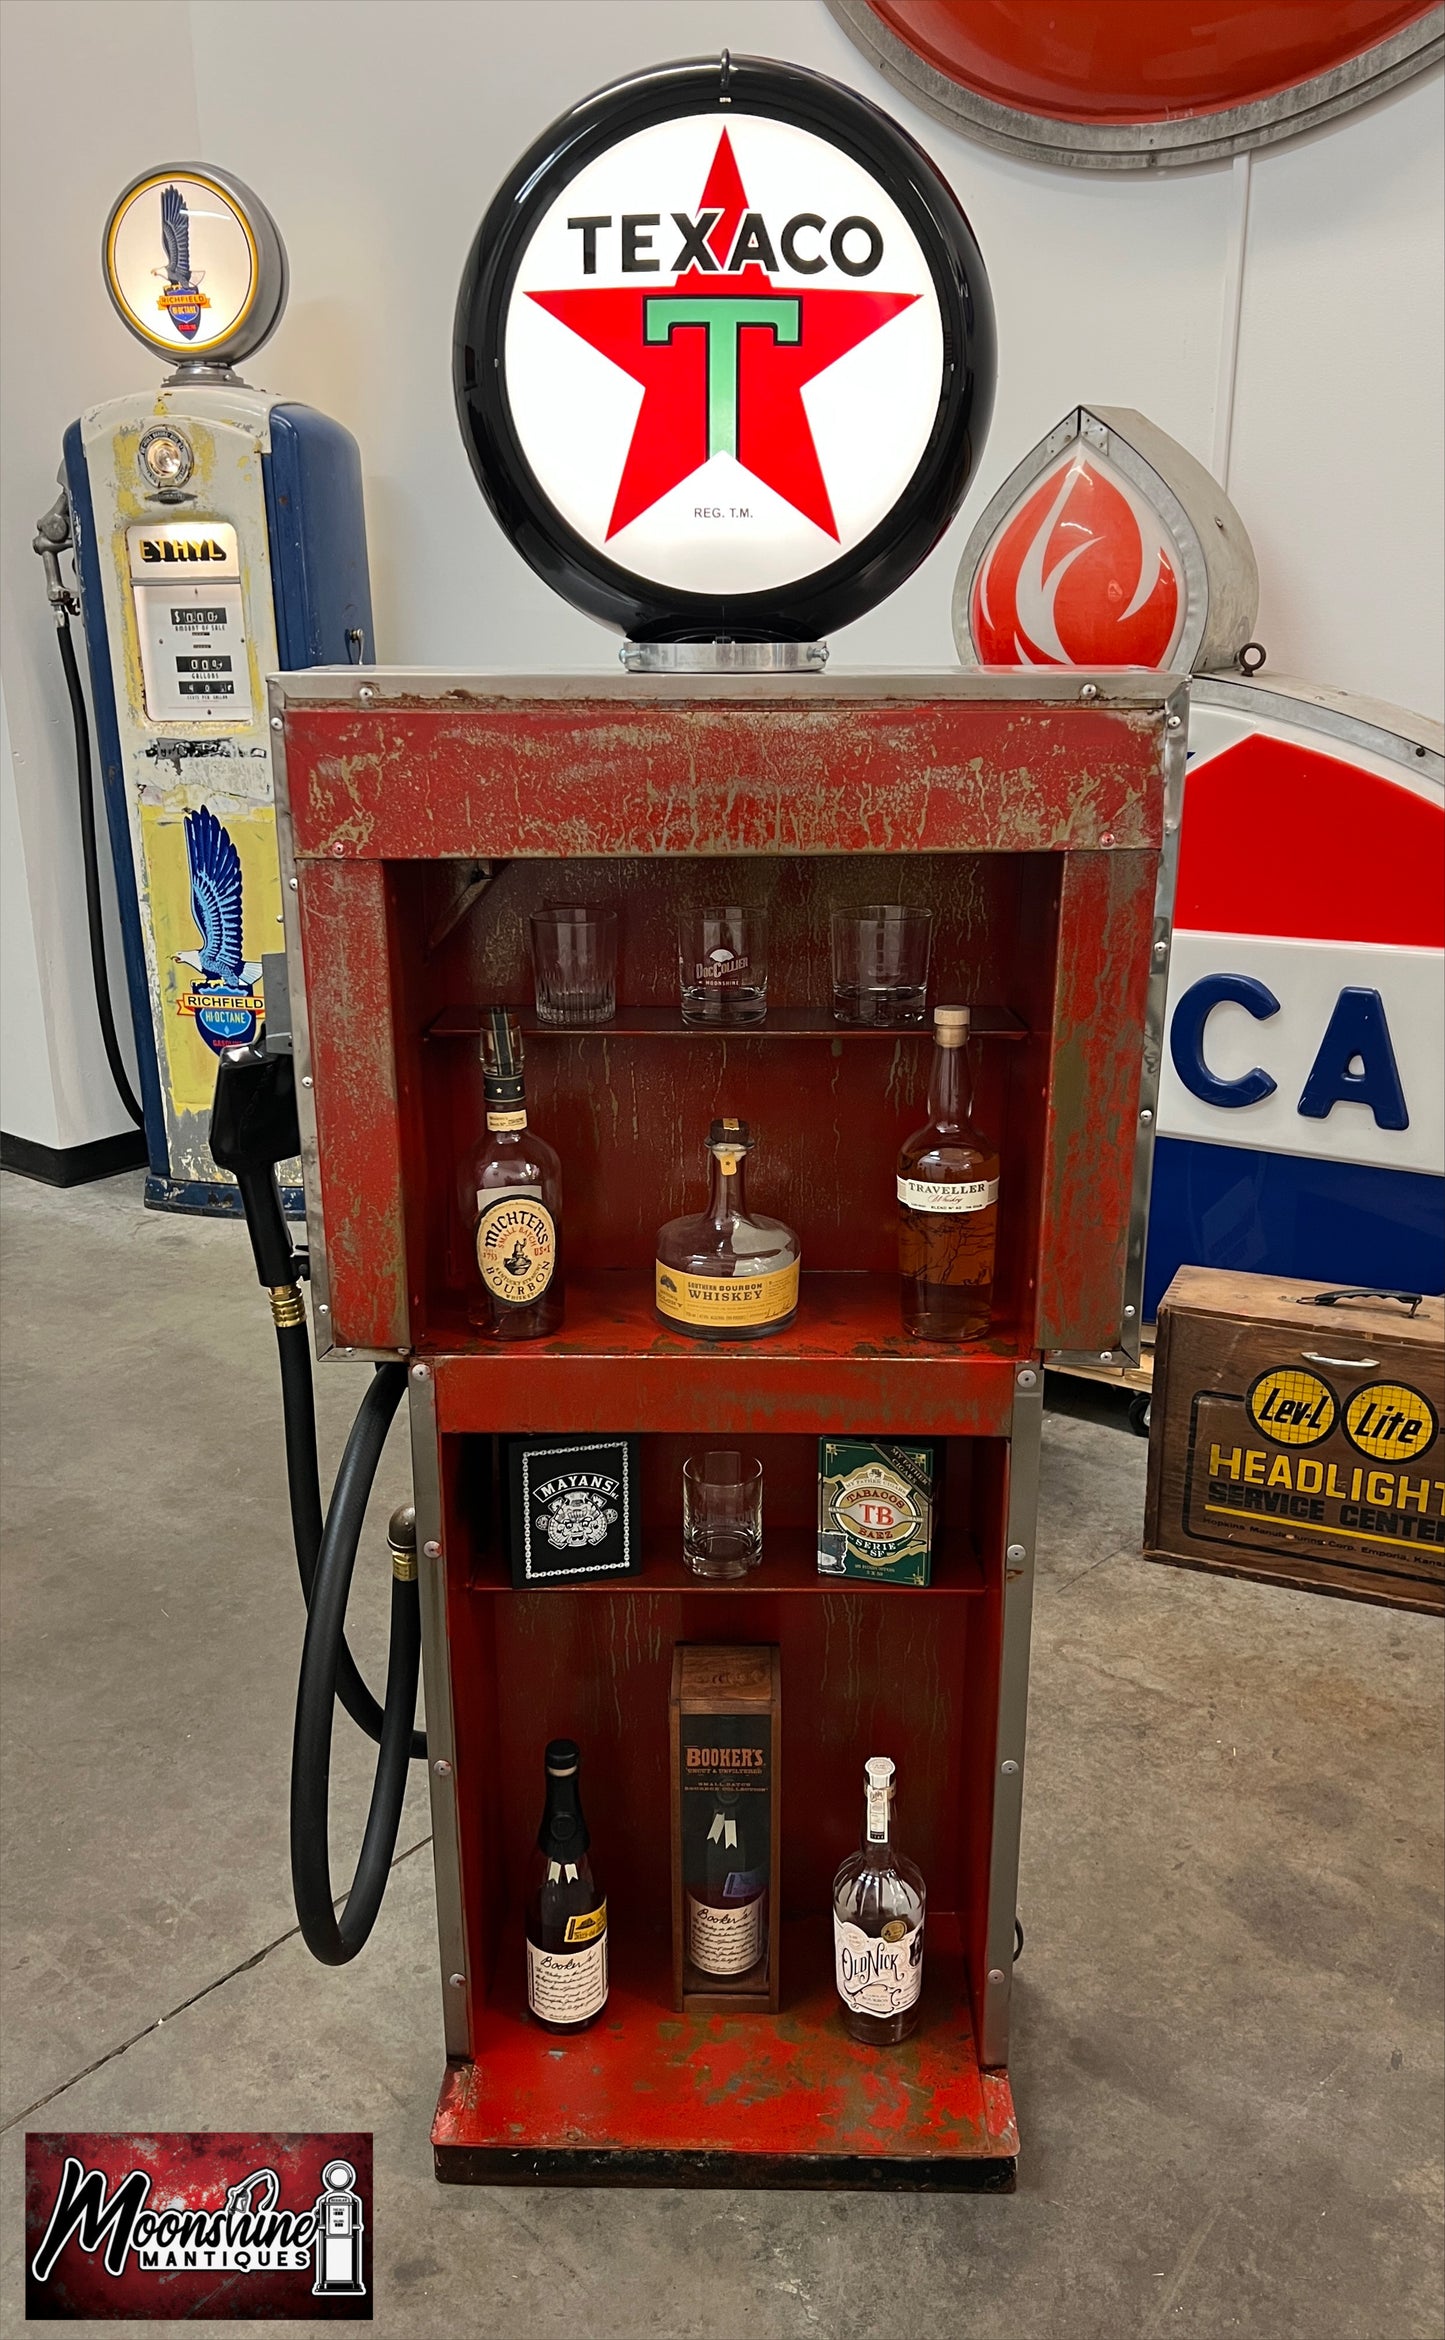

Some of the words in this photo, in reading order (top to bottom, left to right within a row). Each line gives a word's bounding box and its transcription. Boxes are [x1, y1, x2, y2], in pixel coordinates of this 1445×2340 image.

[567, 213, 884, 277] TEXACO
[161, 295, 204, 303] RICHFIELD
[643, 295, 803, 463] T
[694, 507, 725, 519] REG.
[729, 507, 754, 519] T.M.
[139, 540, 227, 562] ETHYL
[188, 996, 263, 1009] RICHFIELD
[909, 1182, 985, 1194] TRAVELLER
[485, 1210, 549, 1248] MICHTER'S
[499, 1226, 516, 1248] SMALL
[518, 1226, 538, 1247] BATCH
[487, 1261, 551, 1295] BOURBON
[496, 1267, 521, 1286] KENTUCKY
[688, 1281, 717, 1291] SOUTHERN
[719, 1283, 762, 1292] BOURBON
[506, 1292, 536, 1300] WHISKEY
[688, 1289, 762, 1302] WHISKEY
[1258, 1388, 1330, 1430] Lev-L
[1354, 1403, 1424, 1444] Lite
[890, 1448, 904, 1459] MY
[902, 1460, 928, 1485] FATHER
[892, 1458, 918, 1483] CIGARS
[541, 1475, 614, 1497] MAYANS
[1208, 1443, 1445, 1516] HEADLIGHT
[847, 1489, 904, 1509] TABACOS
[1208, 1481, 1325, 1521] SERVICE
[859, 1503, 894, 1526] TB
[858, 1528, 893, 1539] BAEZ
[1203, 1517, 1246, 1531] Hopkins
[1250, 1526, 1324, 1545] Manufturing
[1328, 1540, 1357, 1552] Corp.
[855, 1538, 896, 1551] SERIE
[687, 1748, 763, 1767] BOOKER'S
[697, 1908, 752, 1925] Booker's
[540, 1950, 597, 1970] Booker's
